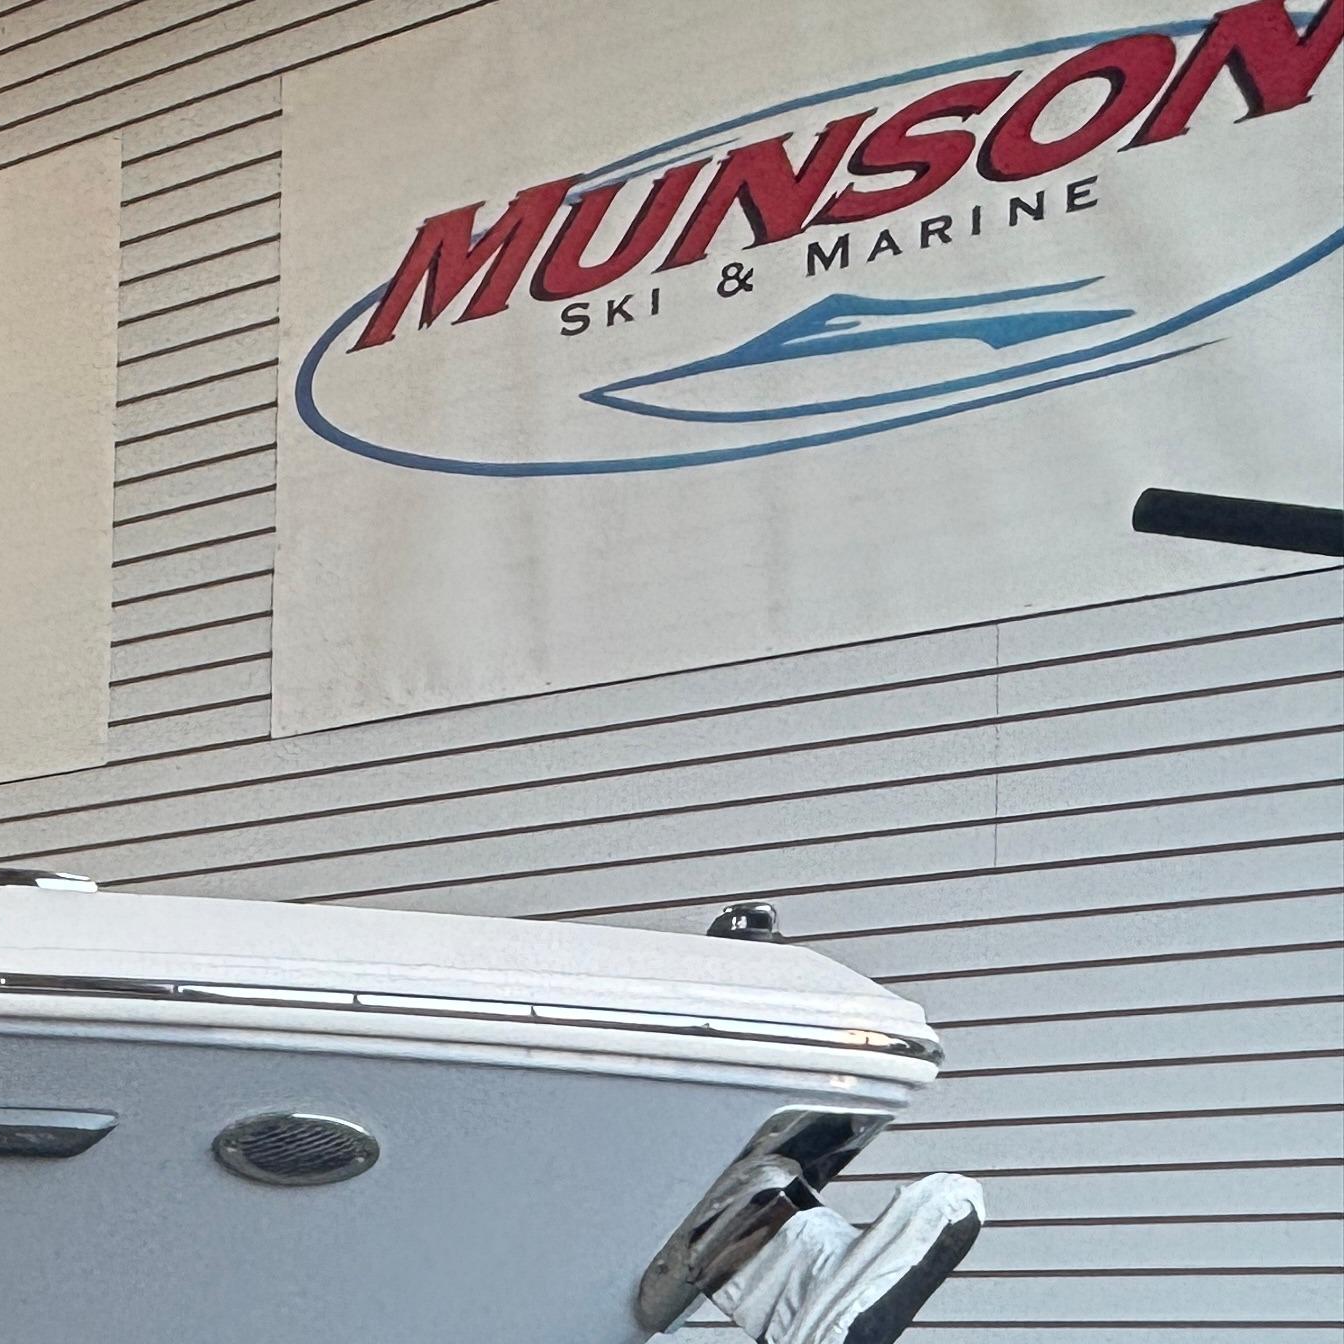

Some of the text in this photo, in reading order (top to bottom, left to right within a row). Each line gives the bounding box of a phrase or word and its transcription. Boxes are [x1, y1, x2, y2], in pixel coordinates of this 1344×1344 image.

[348, 0, 1344, 352] MUNSON
[561, 176, 1100, 337] SKI & MARINE
